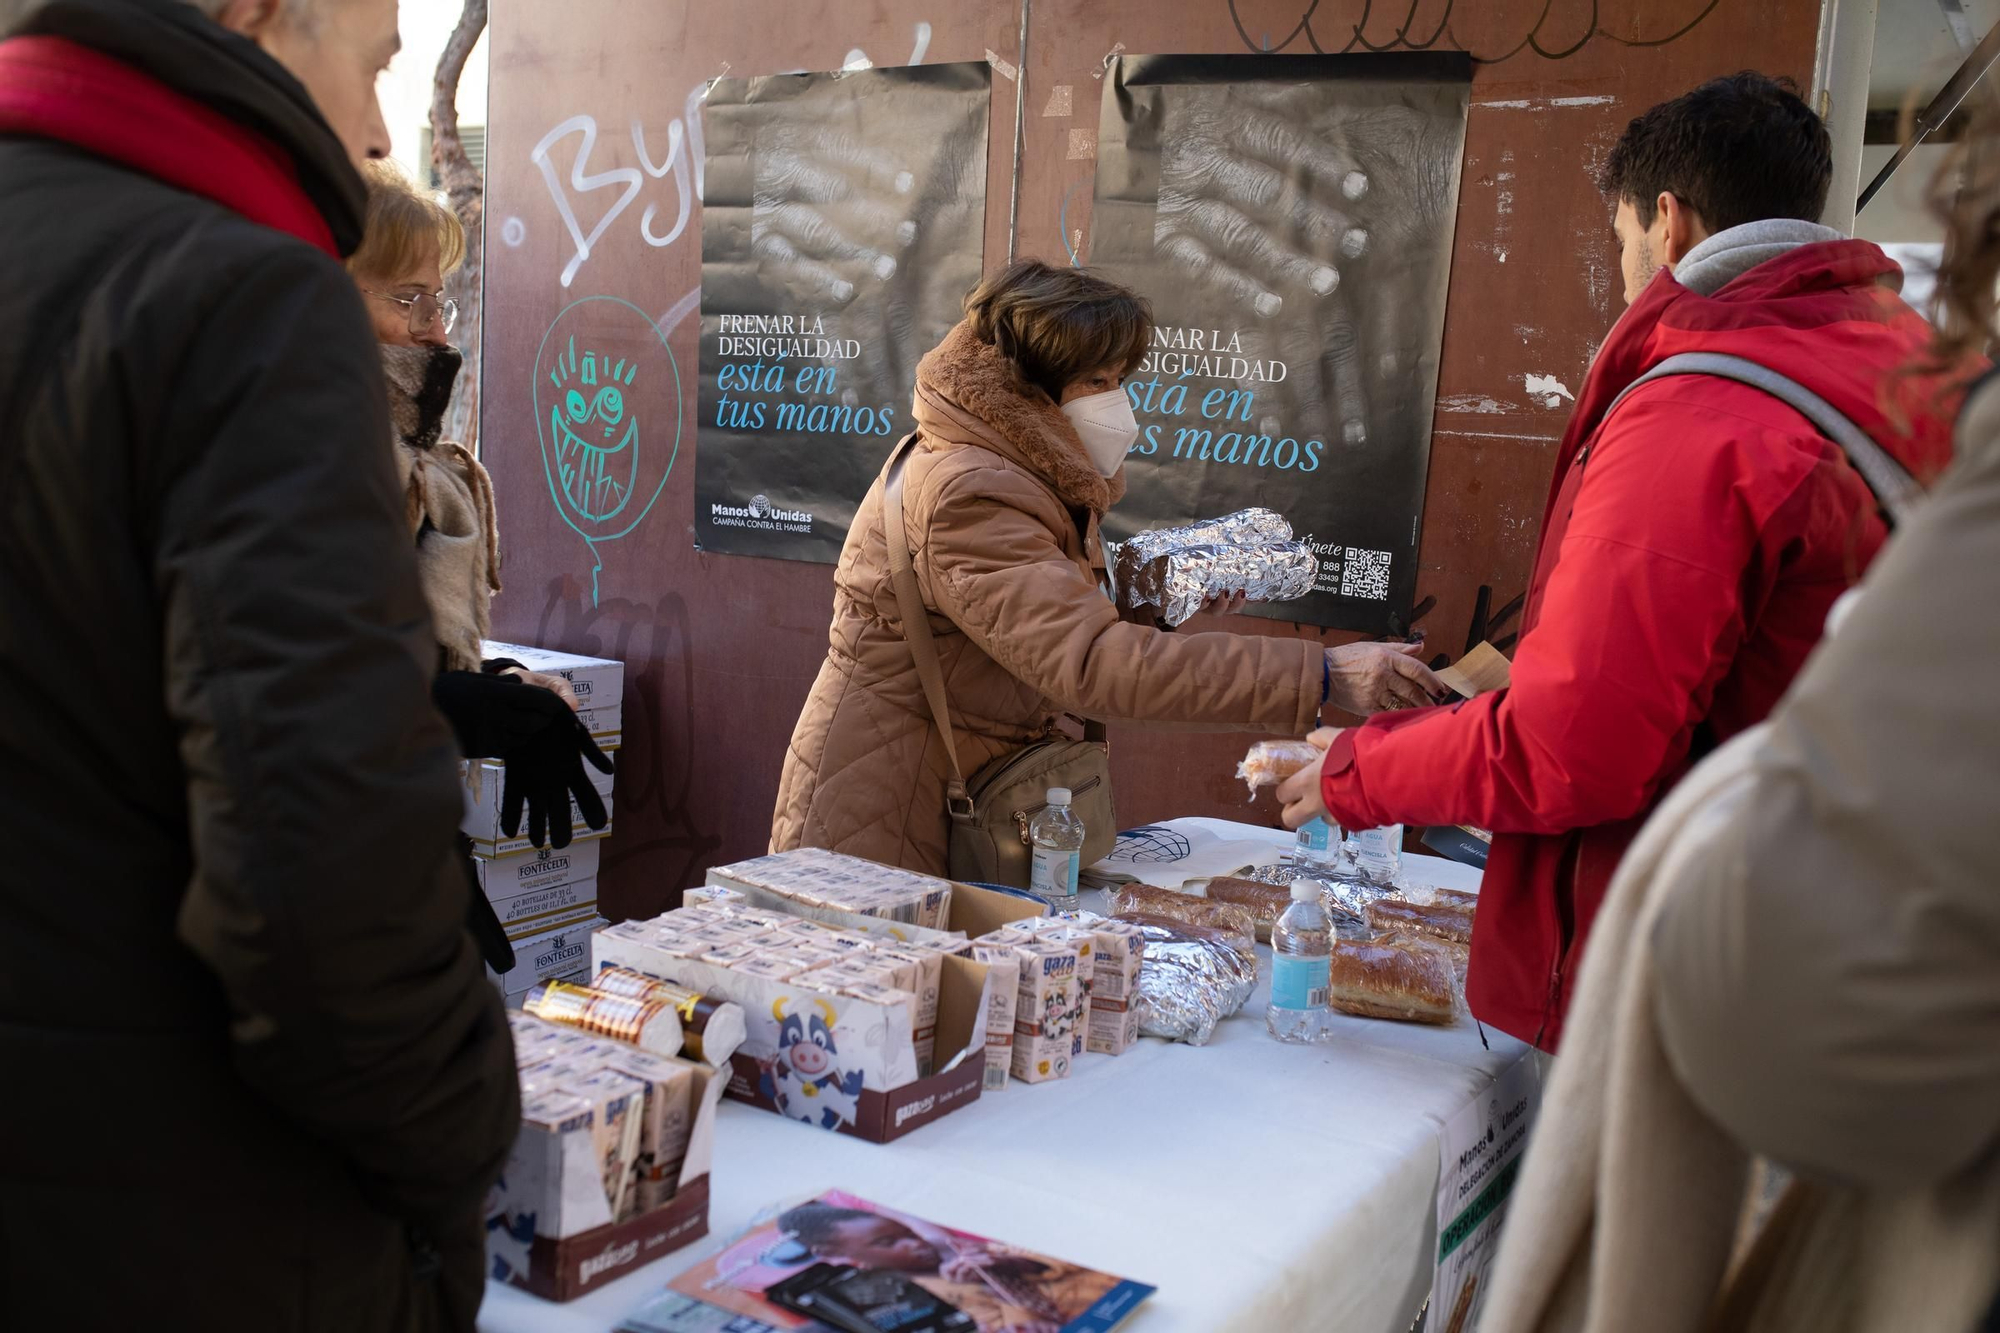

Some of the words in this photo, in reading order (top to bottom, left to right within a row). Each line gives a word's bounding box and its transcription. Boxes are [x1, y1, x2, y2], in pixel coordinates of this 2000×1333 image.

[718, 314, 795, 335] FRENAR
[799, 315, 824, 335] LA
[718, 336, 860, 359] DESIGUALDAD
[1147, 325, 1205, 351] NAR
[1209, 329, 1243, 354] LA
[717, 350, 787, 393] está
[795, 365, 836, 395] en
[1138, 351, 1288, 383] SIGUALDAD
[1120, 368, 1189, 416] stá
[1201, 386, 1254, 422] en
[716, 392, 767, 429] tus
[776, 402, 894, 436] manos
[1173, 427, 1324, 472] manos
[711, 503, 749, 518] Manos
[770, 508, 813, 523] Unidas
[712, 516, 746, 527] CAMPAÑA
[746, 519, 775, 531] CONTRA
[775, 522, 783, 531] EL
[783, 523, 812, 533] HAMBRE
[1322, 561, 1341, 572] 888
[1318, 573, 1339, 583] 33439
[1311, 584, 1338, 595] das.org
[519, 857, 569, 877] FONTECELTA
[512, 899, 521, 910] 40
[521, 893, 549, 907] BOTELLAS
[506, 911, 515, 922] 40
[536, 944, 583, 968] FONTECELTA
[1043, 955, 1076, 976] gaza
[1459, 1135, 1487, 1174] Manos
[1502, 1096, 1528, 1131] Unidas
